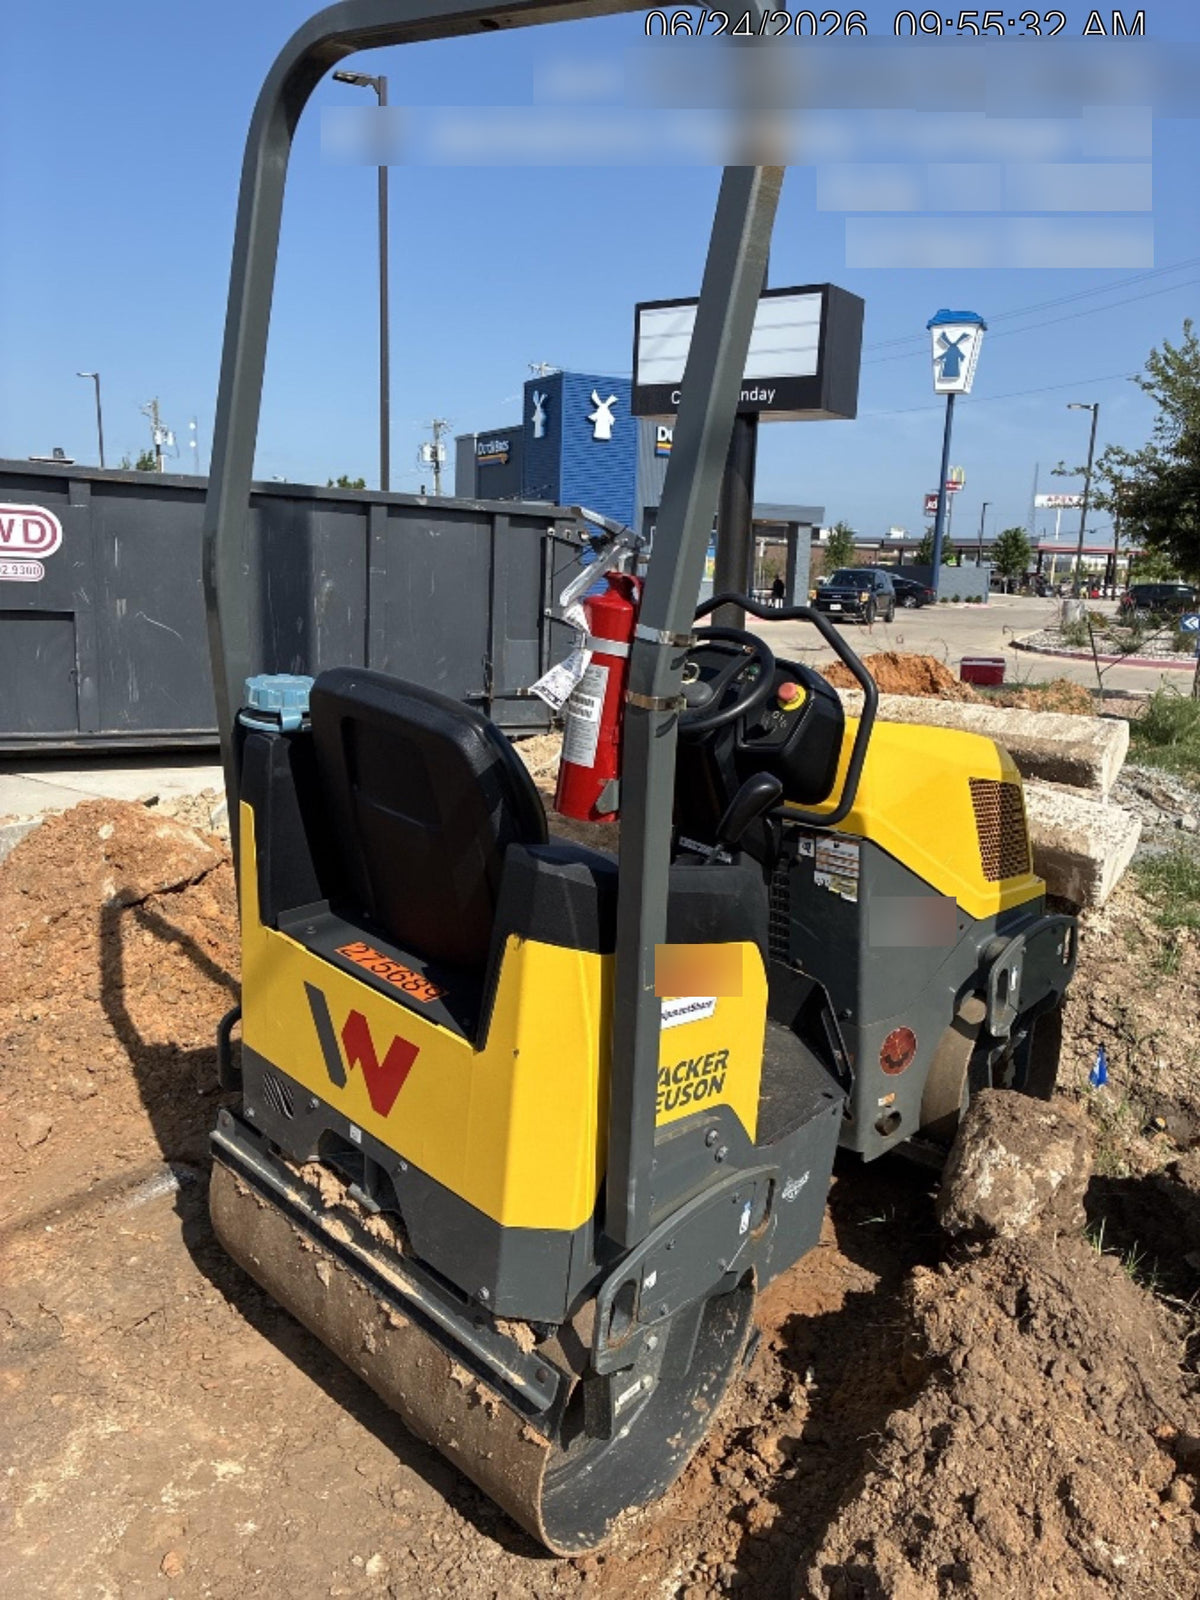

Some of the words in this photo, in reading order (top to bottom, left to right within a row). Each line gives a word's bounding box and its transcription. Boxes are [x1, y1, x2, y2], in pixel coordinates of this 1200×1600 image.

[738, 386, 776, 404] nday
[657, 1048, 730, 1087] ACKER
[655, 1071, 726, 1114] EUSON
